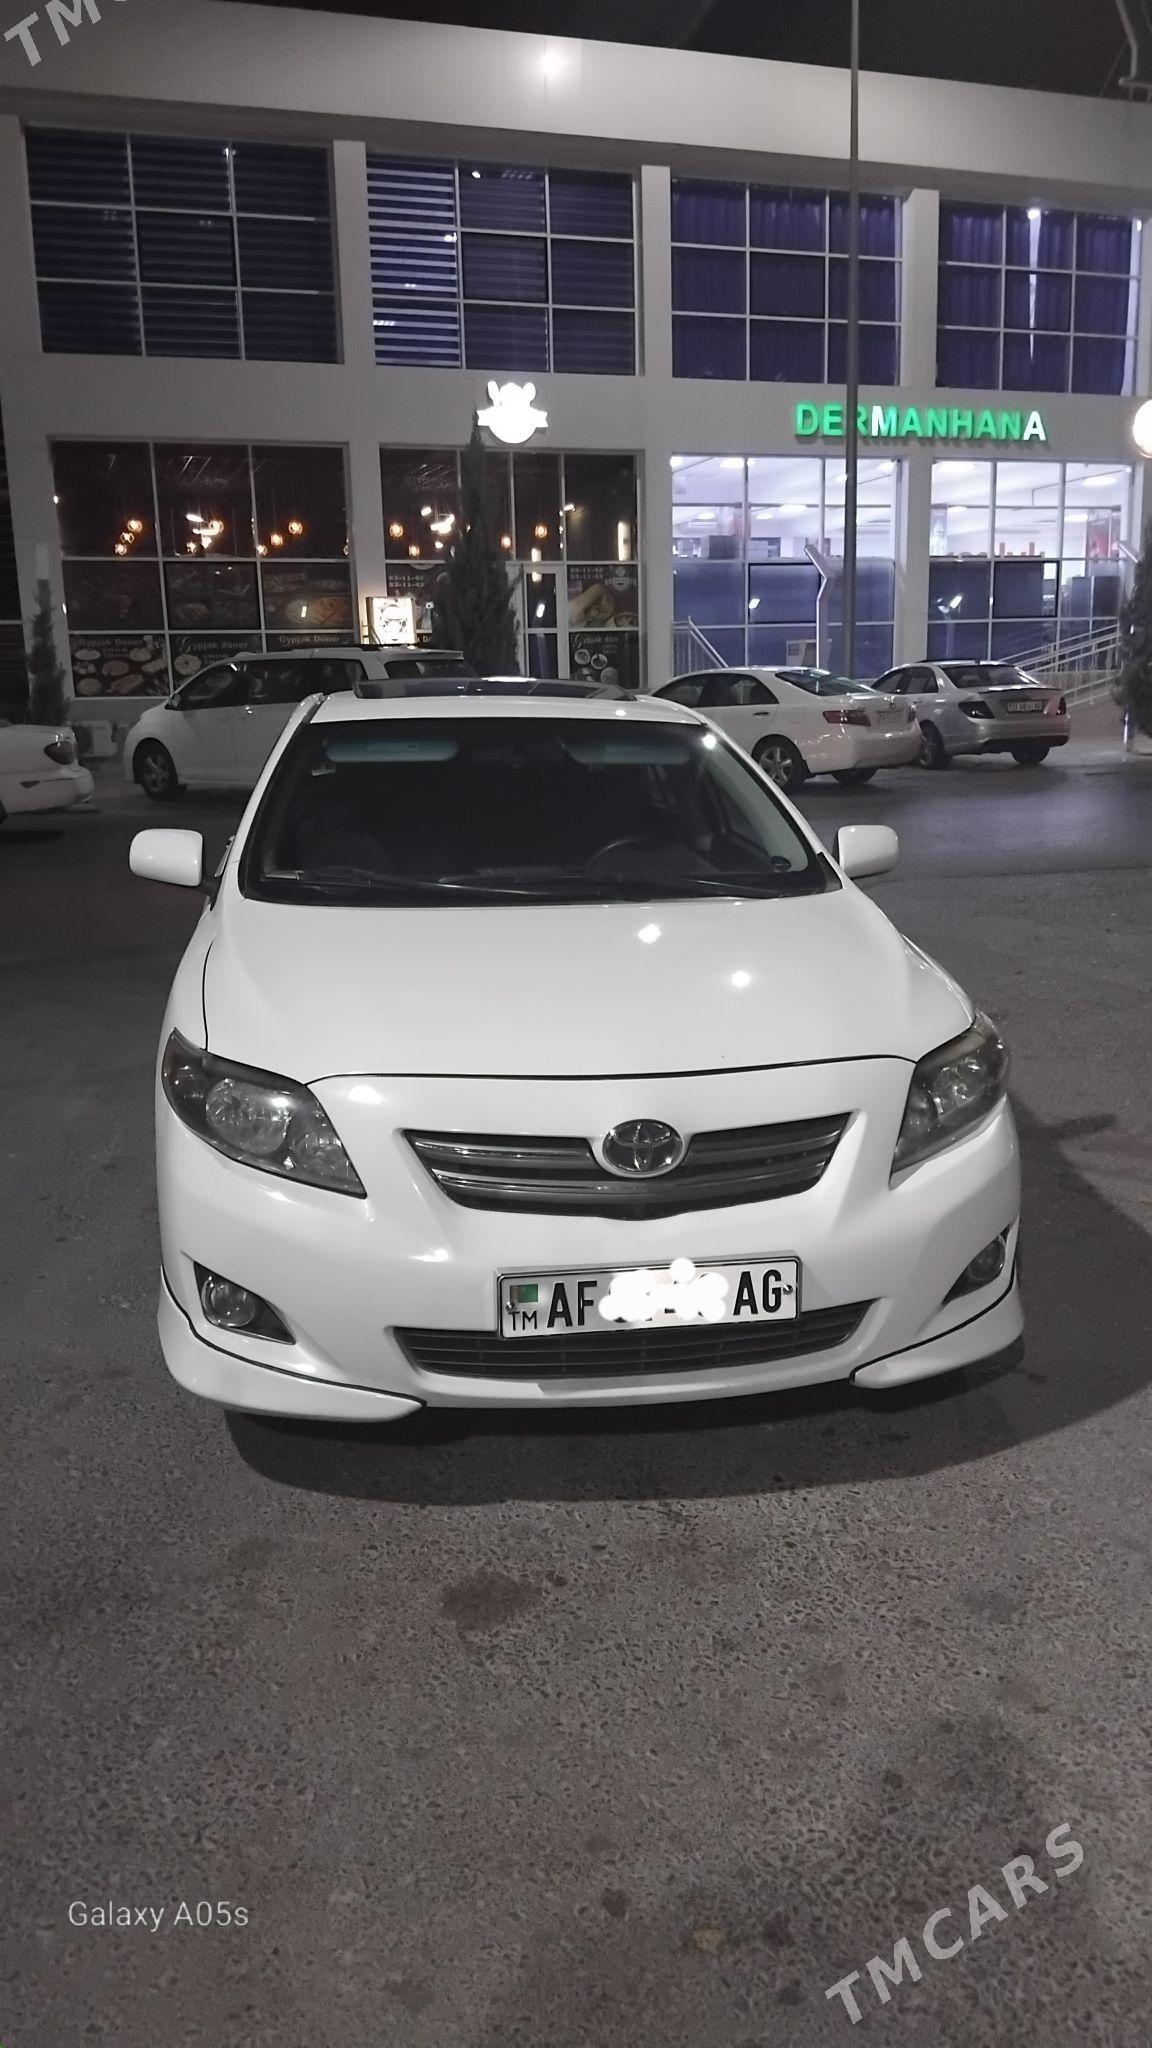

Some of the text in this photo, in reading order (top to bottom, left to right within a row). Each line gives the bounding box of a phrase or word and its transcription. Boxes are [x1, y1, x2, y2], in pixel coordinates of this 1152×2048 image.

[795, 403, 1046, 441] DERMANHANA
[546, 1280, 598, 1328] AF
[732, 1269, 783, 1317] AG
[508, 1311, 538, 1332] TM
